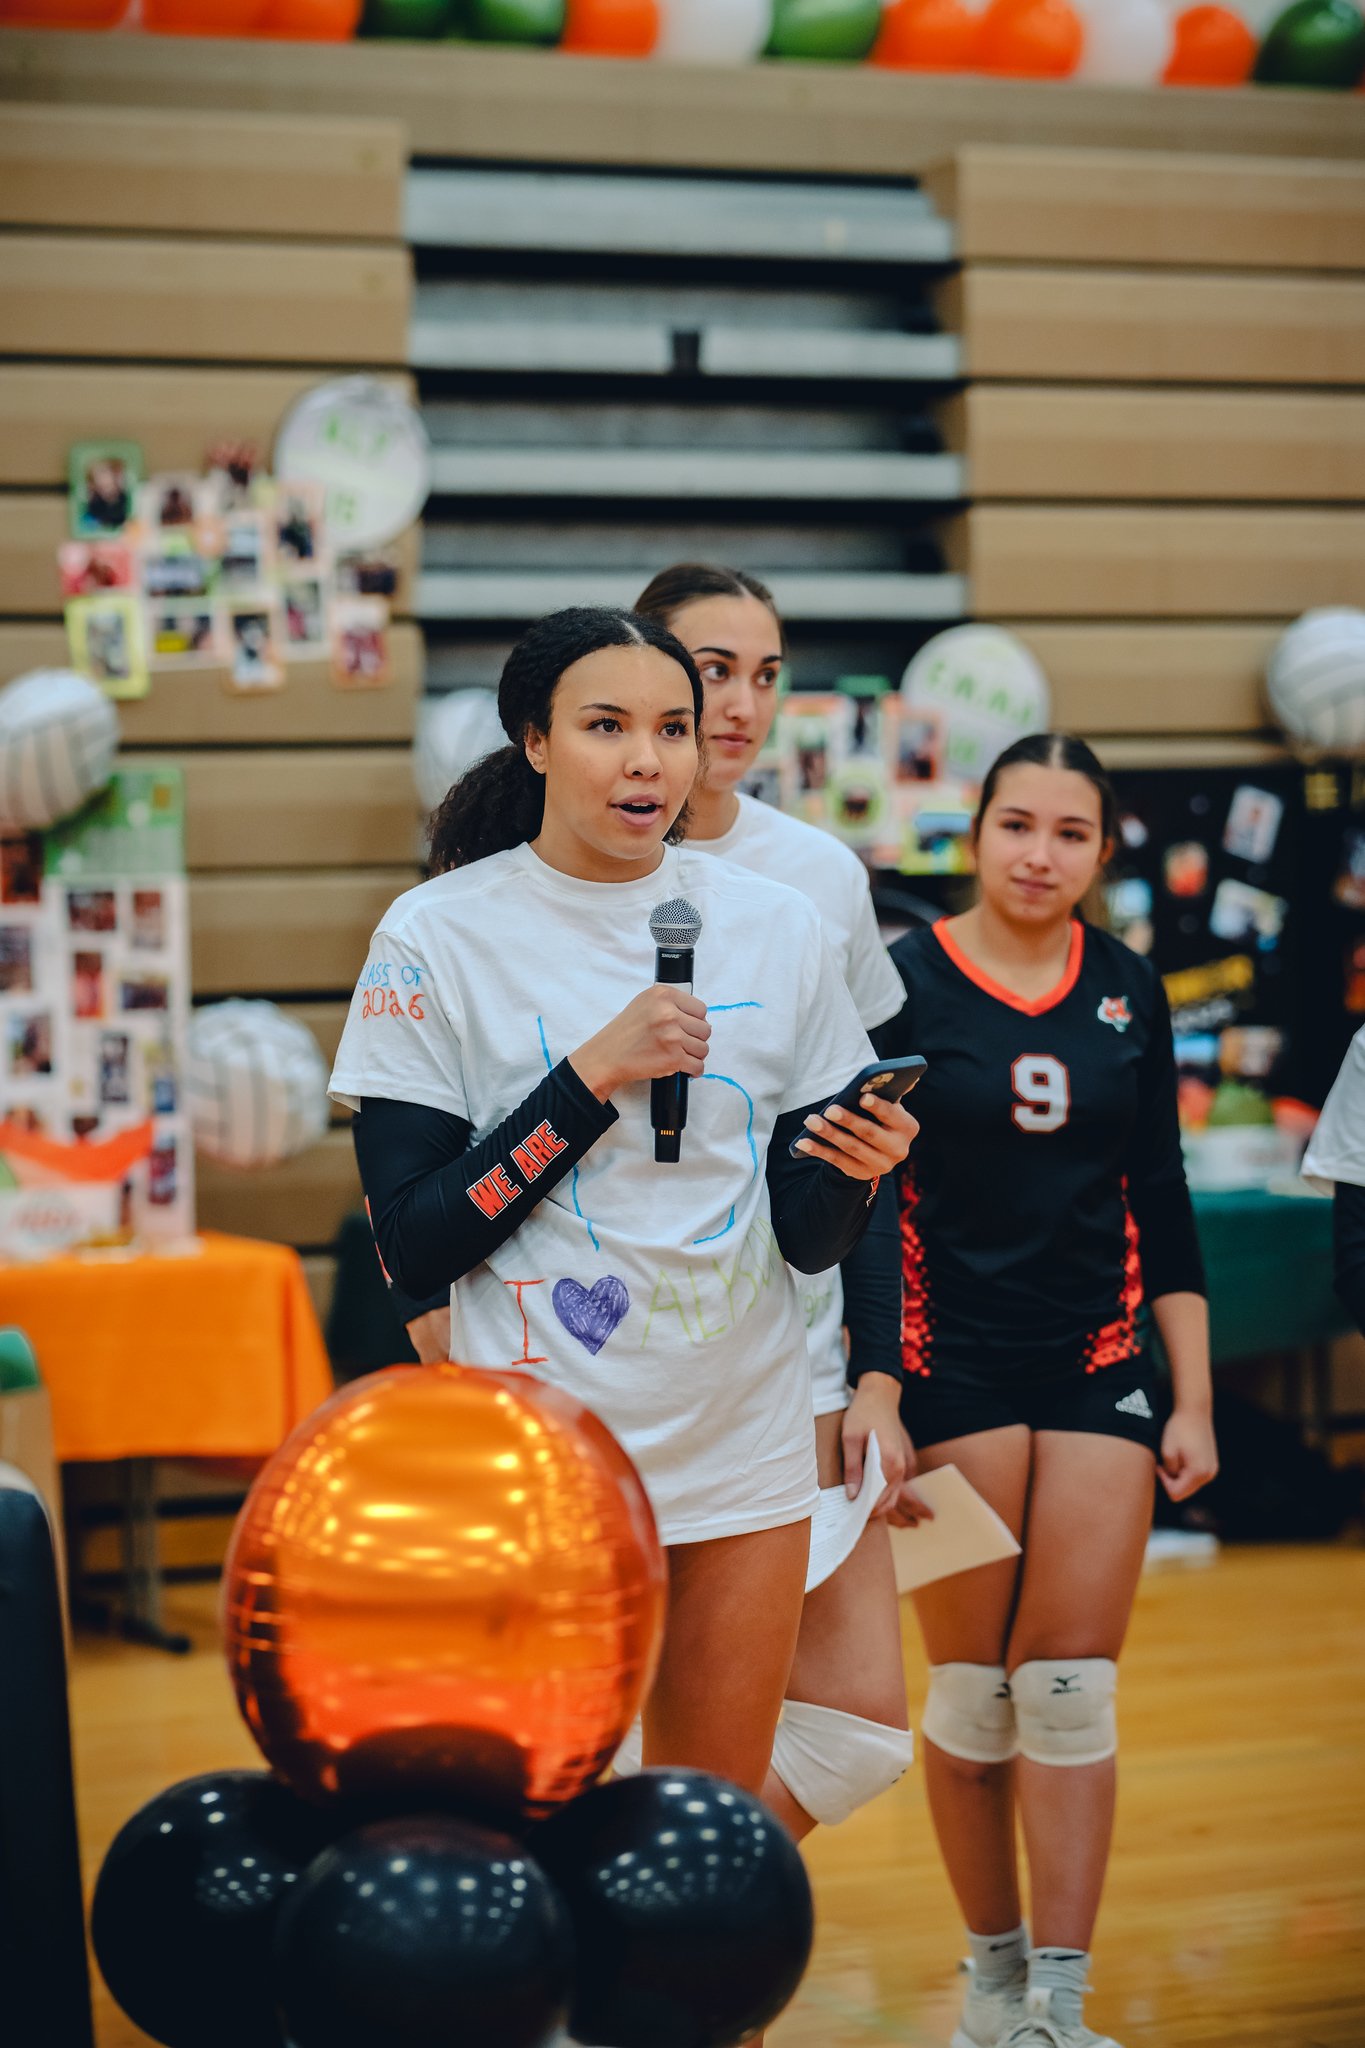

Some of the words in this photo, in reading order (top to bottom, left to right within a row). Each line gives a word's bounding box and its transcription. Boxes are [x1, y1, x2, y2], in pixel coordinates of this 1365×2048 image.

[362, 987, 424, 1021] 2026
[401, 965, 427, 987] OF
[1010, 1052, 1071, 1134] 9
[466, 1162, 523, 1220] WE
[509, 1118, 569, 1183] ARE
[503, 1279, 548, 1365] I
